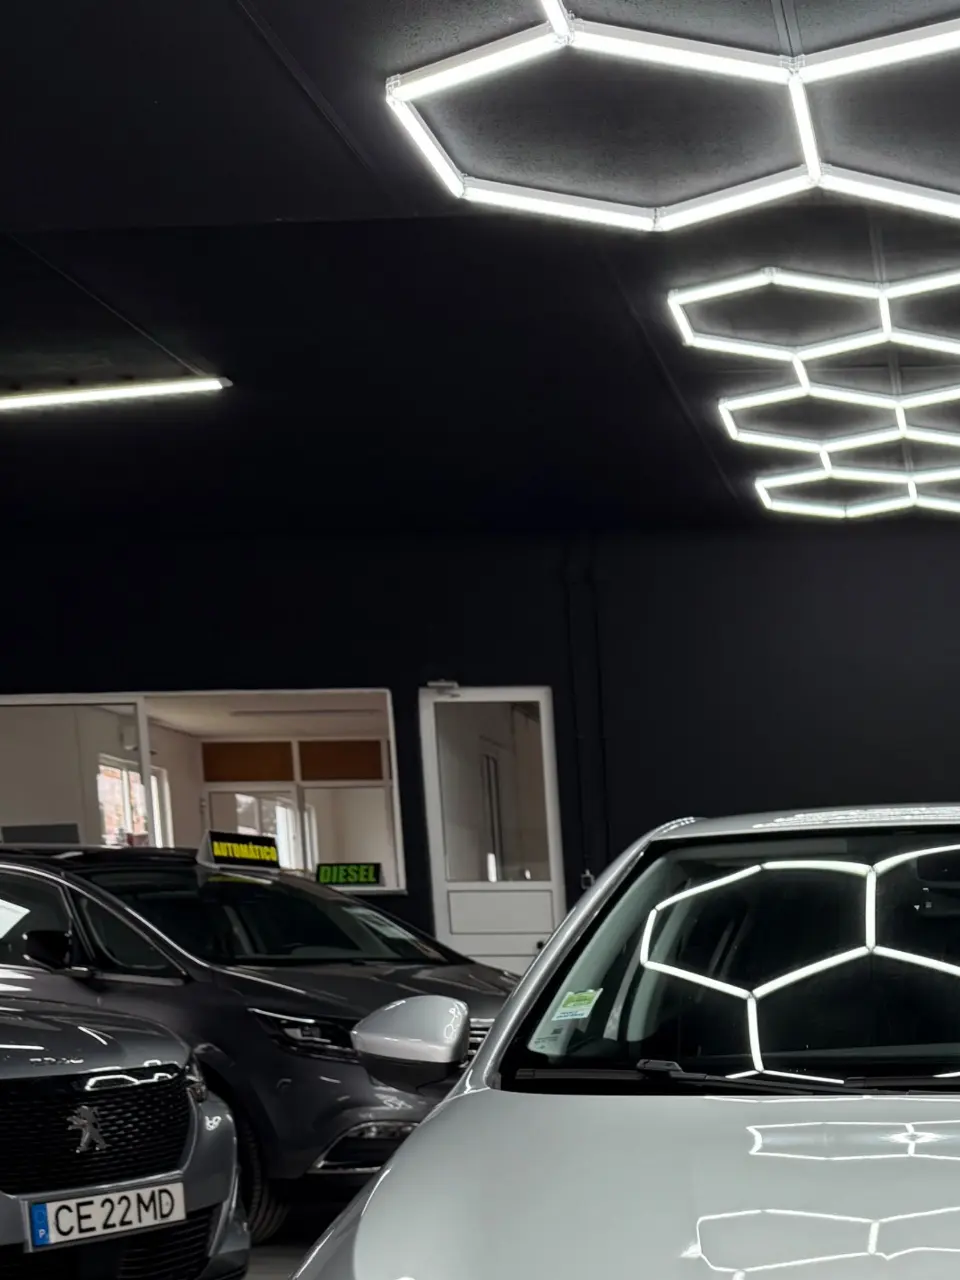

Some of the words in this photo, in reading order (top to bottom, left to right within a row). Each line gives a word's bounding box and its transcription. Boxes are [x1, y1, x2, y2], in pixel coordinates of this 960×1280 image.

[212, 841, 278, 862] AUTOMÁTICO
[319, 865, 377, 884] DIESEL
[38, 1229, 46, 1239] P
